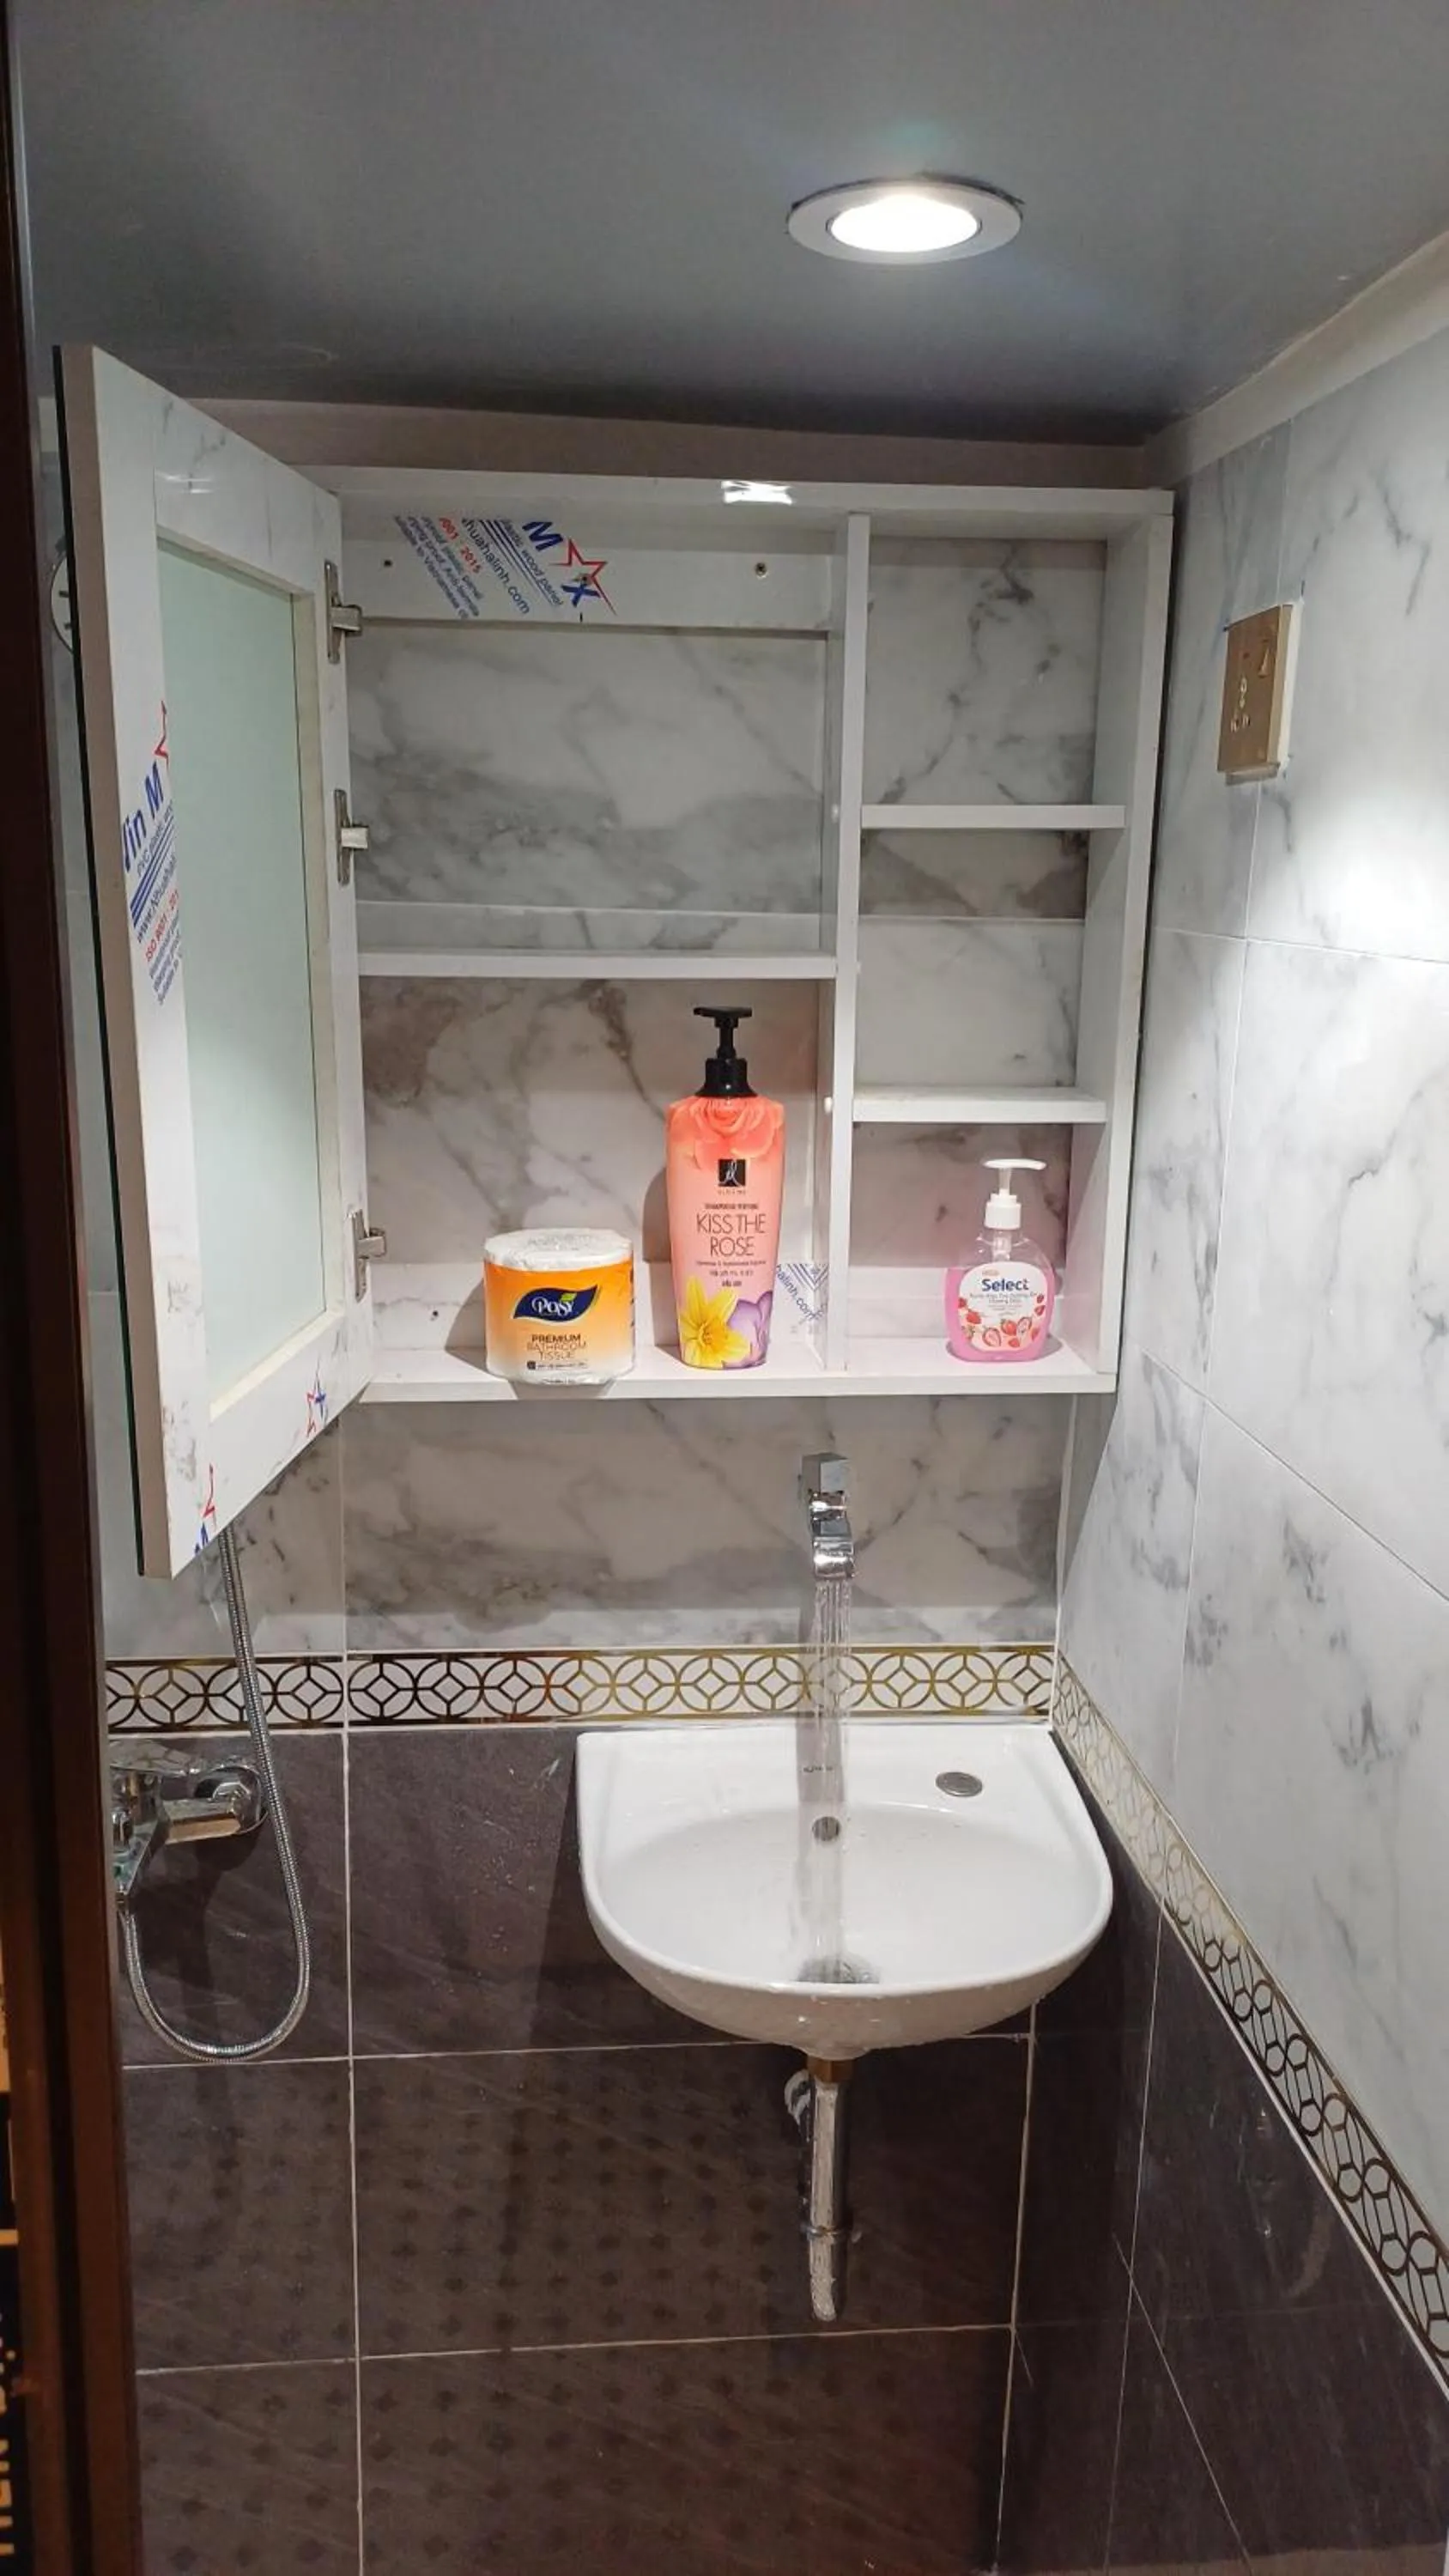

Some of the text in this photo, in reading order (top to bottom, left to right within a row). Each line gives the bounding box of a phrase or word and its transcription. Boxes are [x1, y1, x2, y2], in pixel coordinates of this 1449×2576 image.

[696, 1212, 767, 1234] KISS THE
[710, 1236, 755, 1257] ROSE
[981, 1277, 1030, 1292] Select
[531, 1333, 581, 1342] PREMIUM
